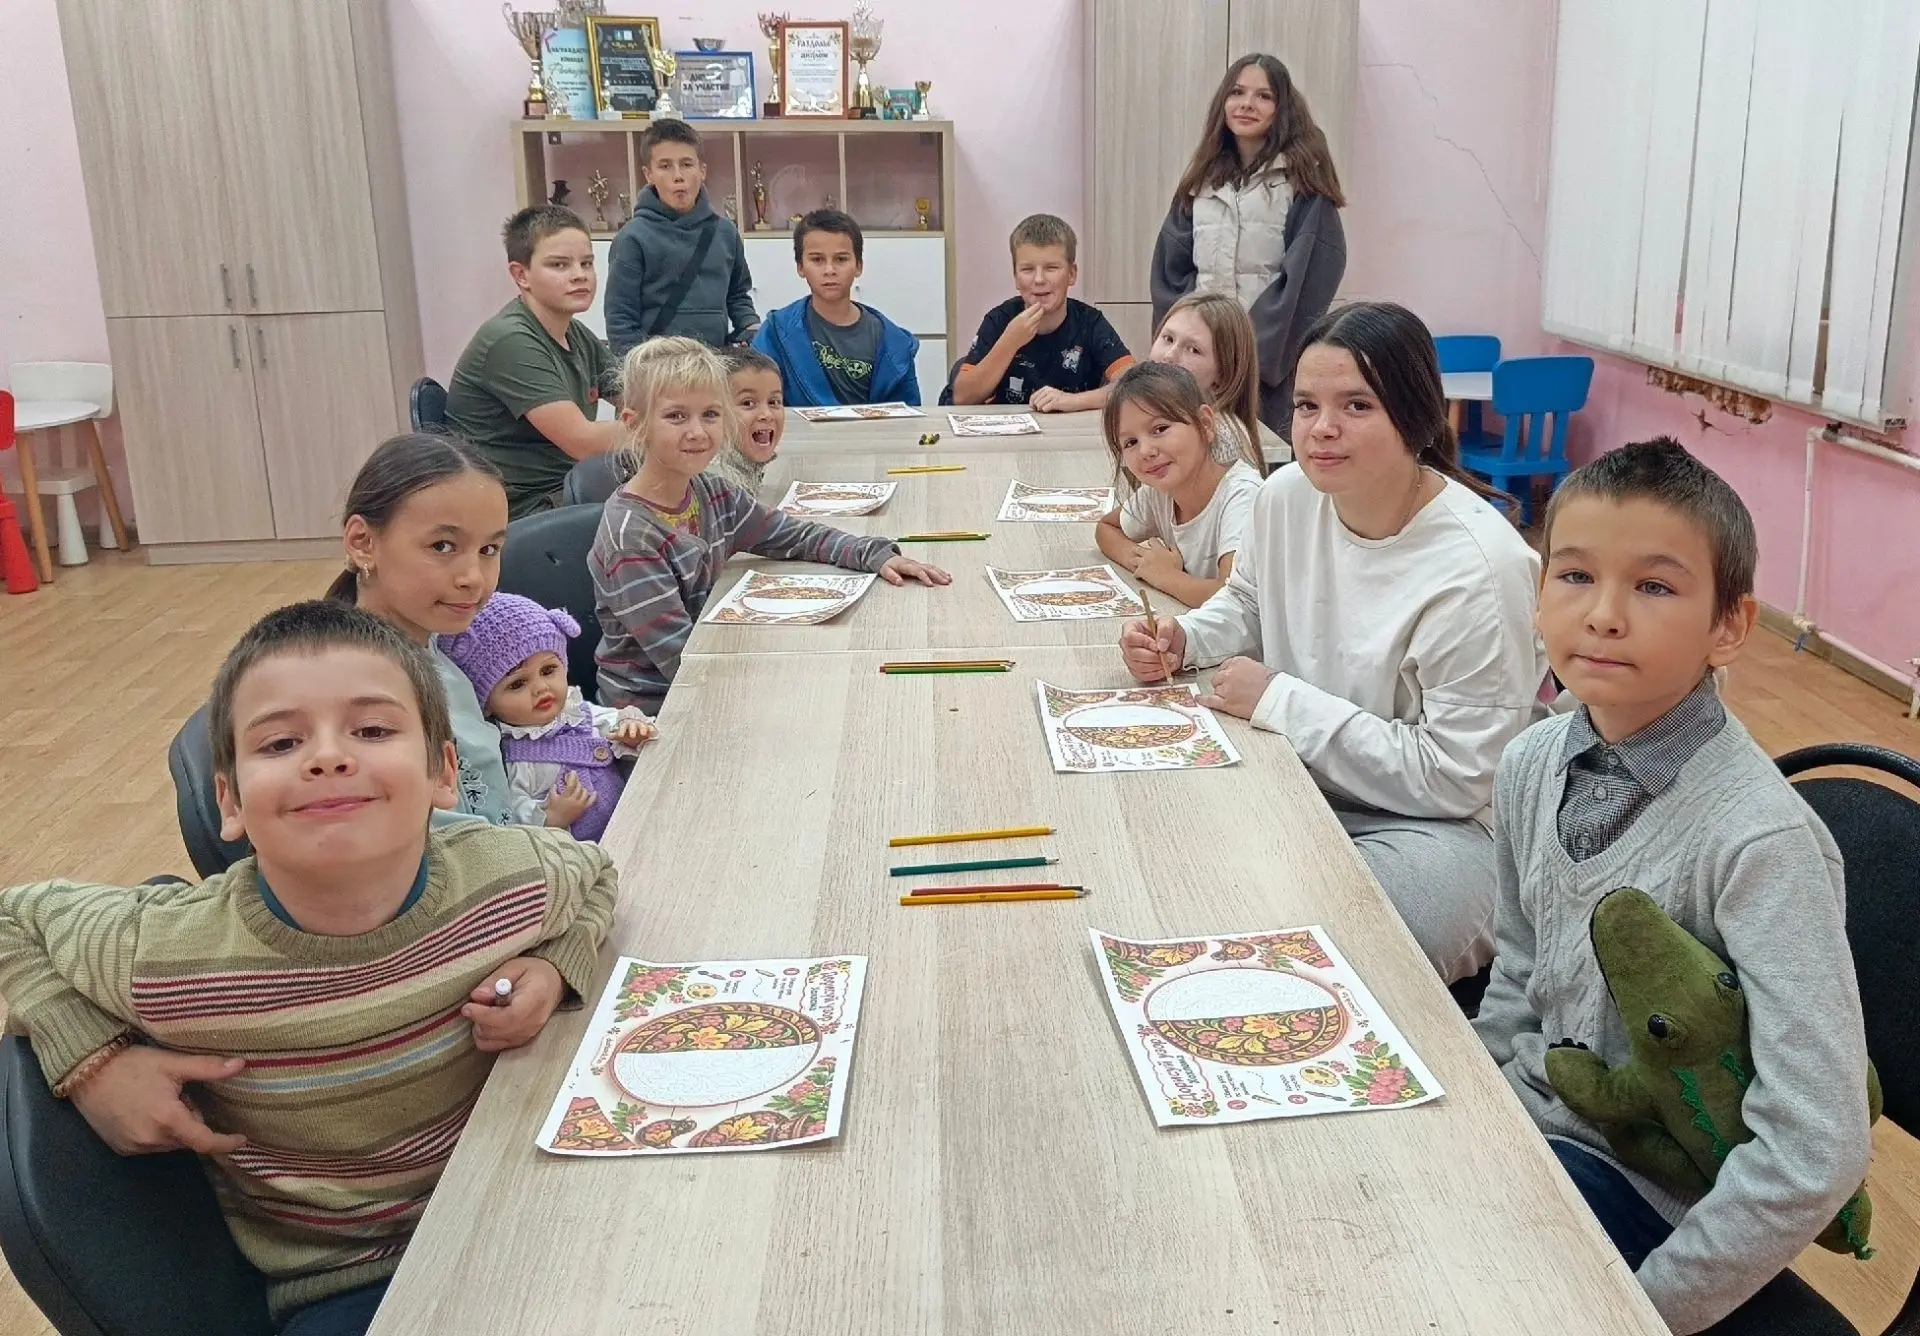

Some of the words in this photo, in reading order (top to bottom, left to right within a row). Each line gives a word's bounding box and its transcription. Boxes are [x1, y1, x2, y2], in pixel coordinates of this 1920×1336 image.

[695, 83, 730, 92] УЧАСТИЕ
[1150, 1039, 1175, 1059] узор
[1157, 1060, 1202, 1102] Дорисуй
